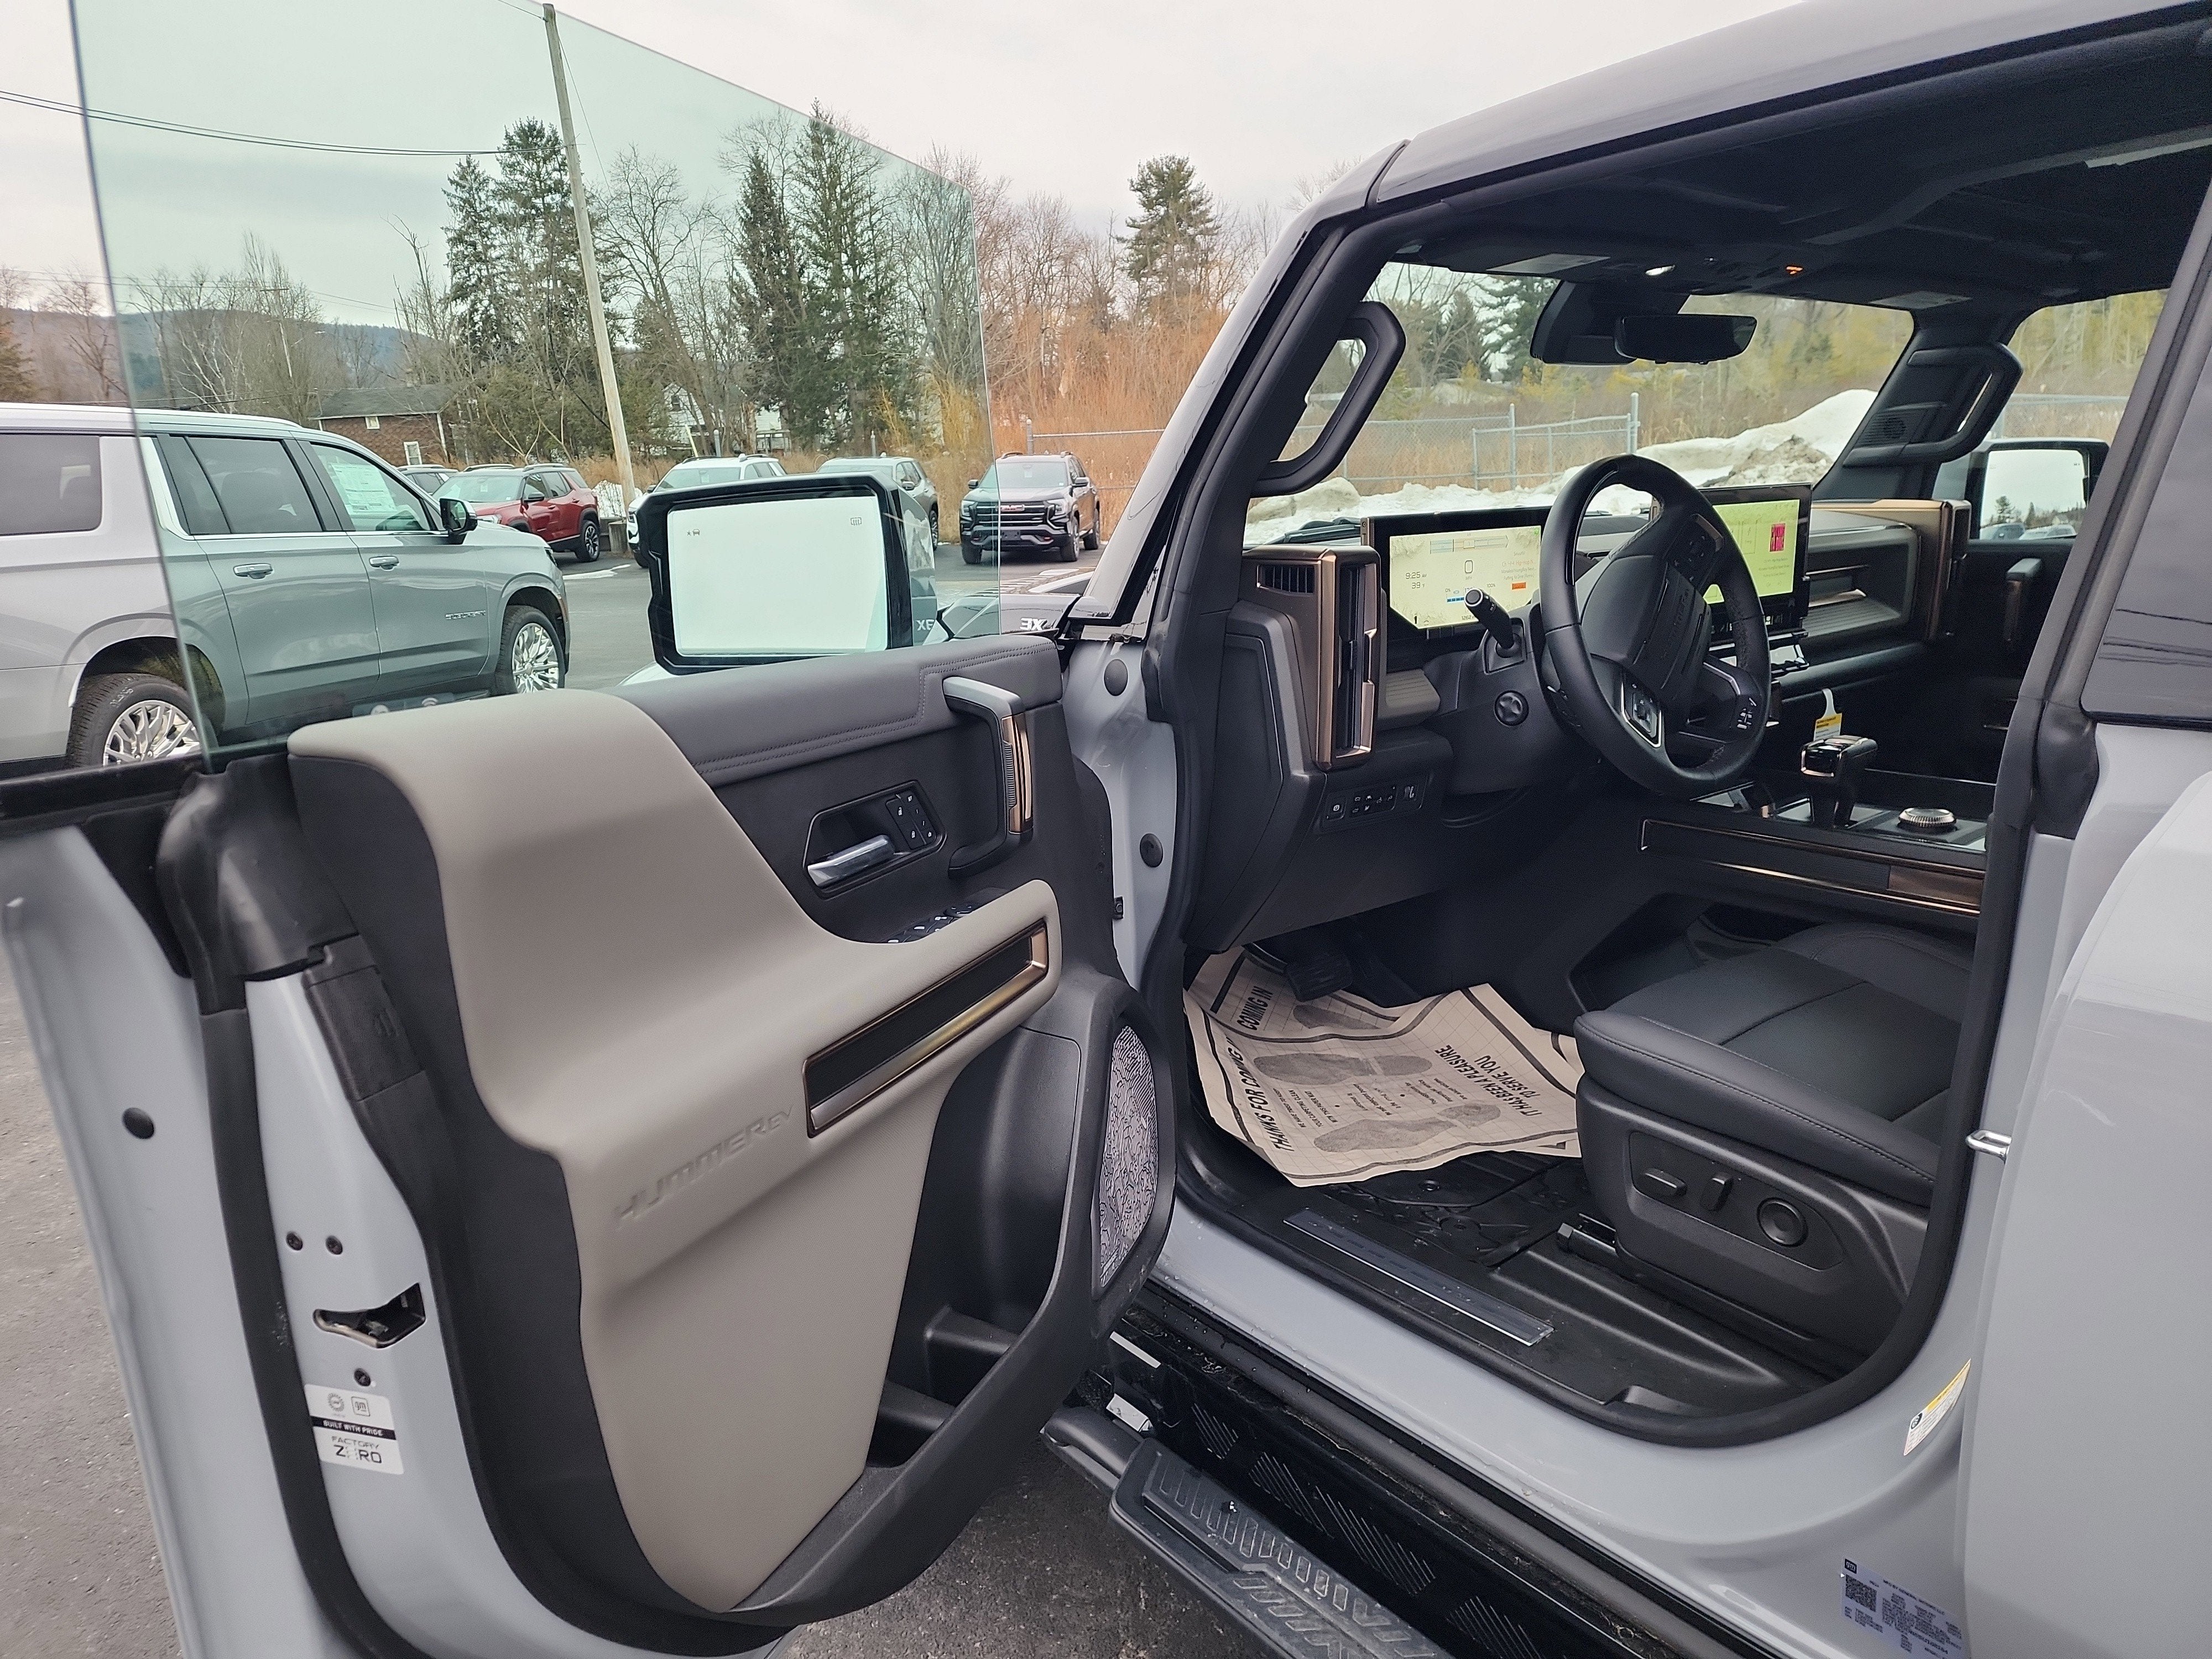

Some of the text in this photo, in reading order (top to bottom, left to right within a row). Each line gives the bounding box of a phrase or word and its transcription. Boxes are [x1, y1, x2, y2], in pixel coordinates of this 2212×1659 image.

[1464, 560, 1473, 573] 0
[1406, 571, 1421, 580] 9:25
[1237, 986, 1273, 1030] COMING IN
[1434, 1045, 1484, 1079] PLEASURE
[1474, 1055, 1501, 1074] YOU
[1491, 1072, 1528, 1091] SERVE
[1288, 1089, 1301, 1100] CLEAN
[1480, 1083, 1514, 1098] BEEN
[1245, 1088, 1271, 1112] FOR
[1503, 1096, 1532, 1110] HAS
[1254, 1112, 1295, 1151] THANKS
[323, 1420, 343, 1430] BUILT
[362, 1427, 383, 1436] PRIDE
[332, 1436, 379, 1449] FACTORY
